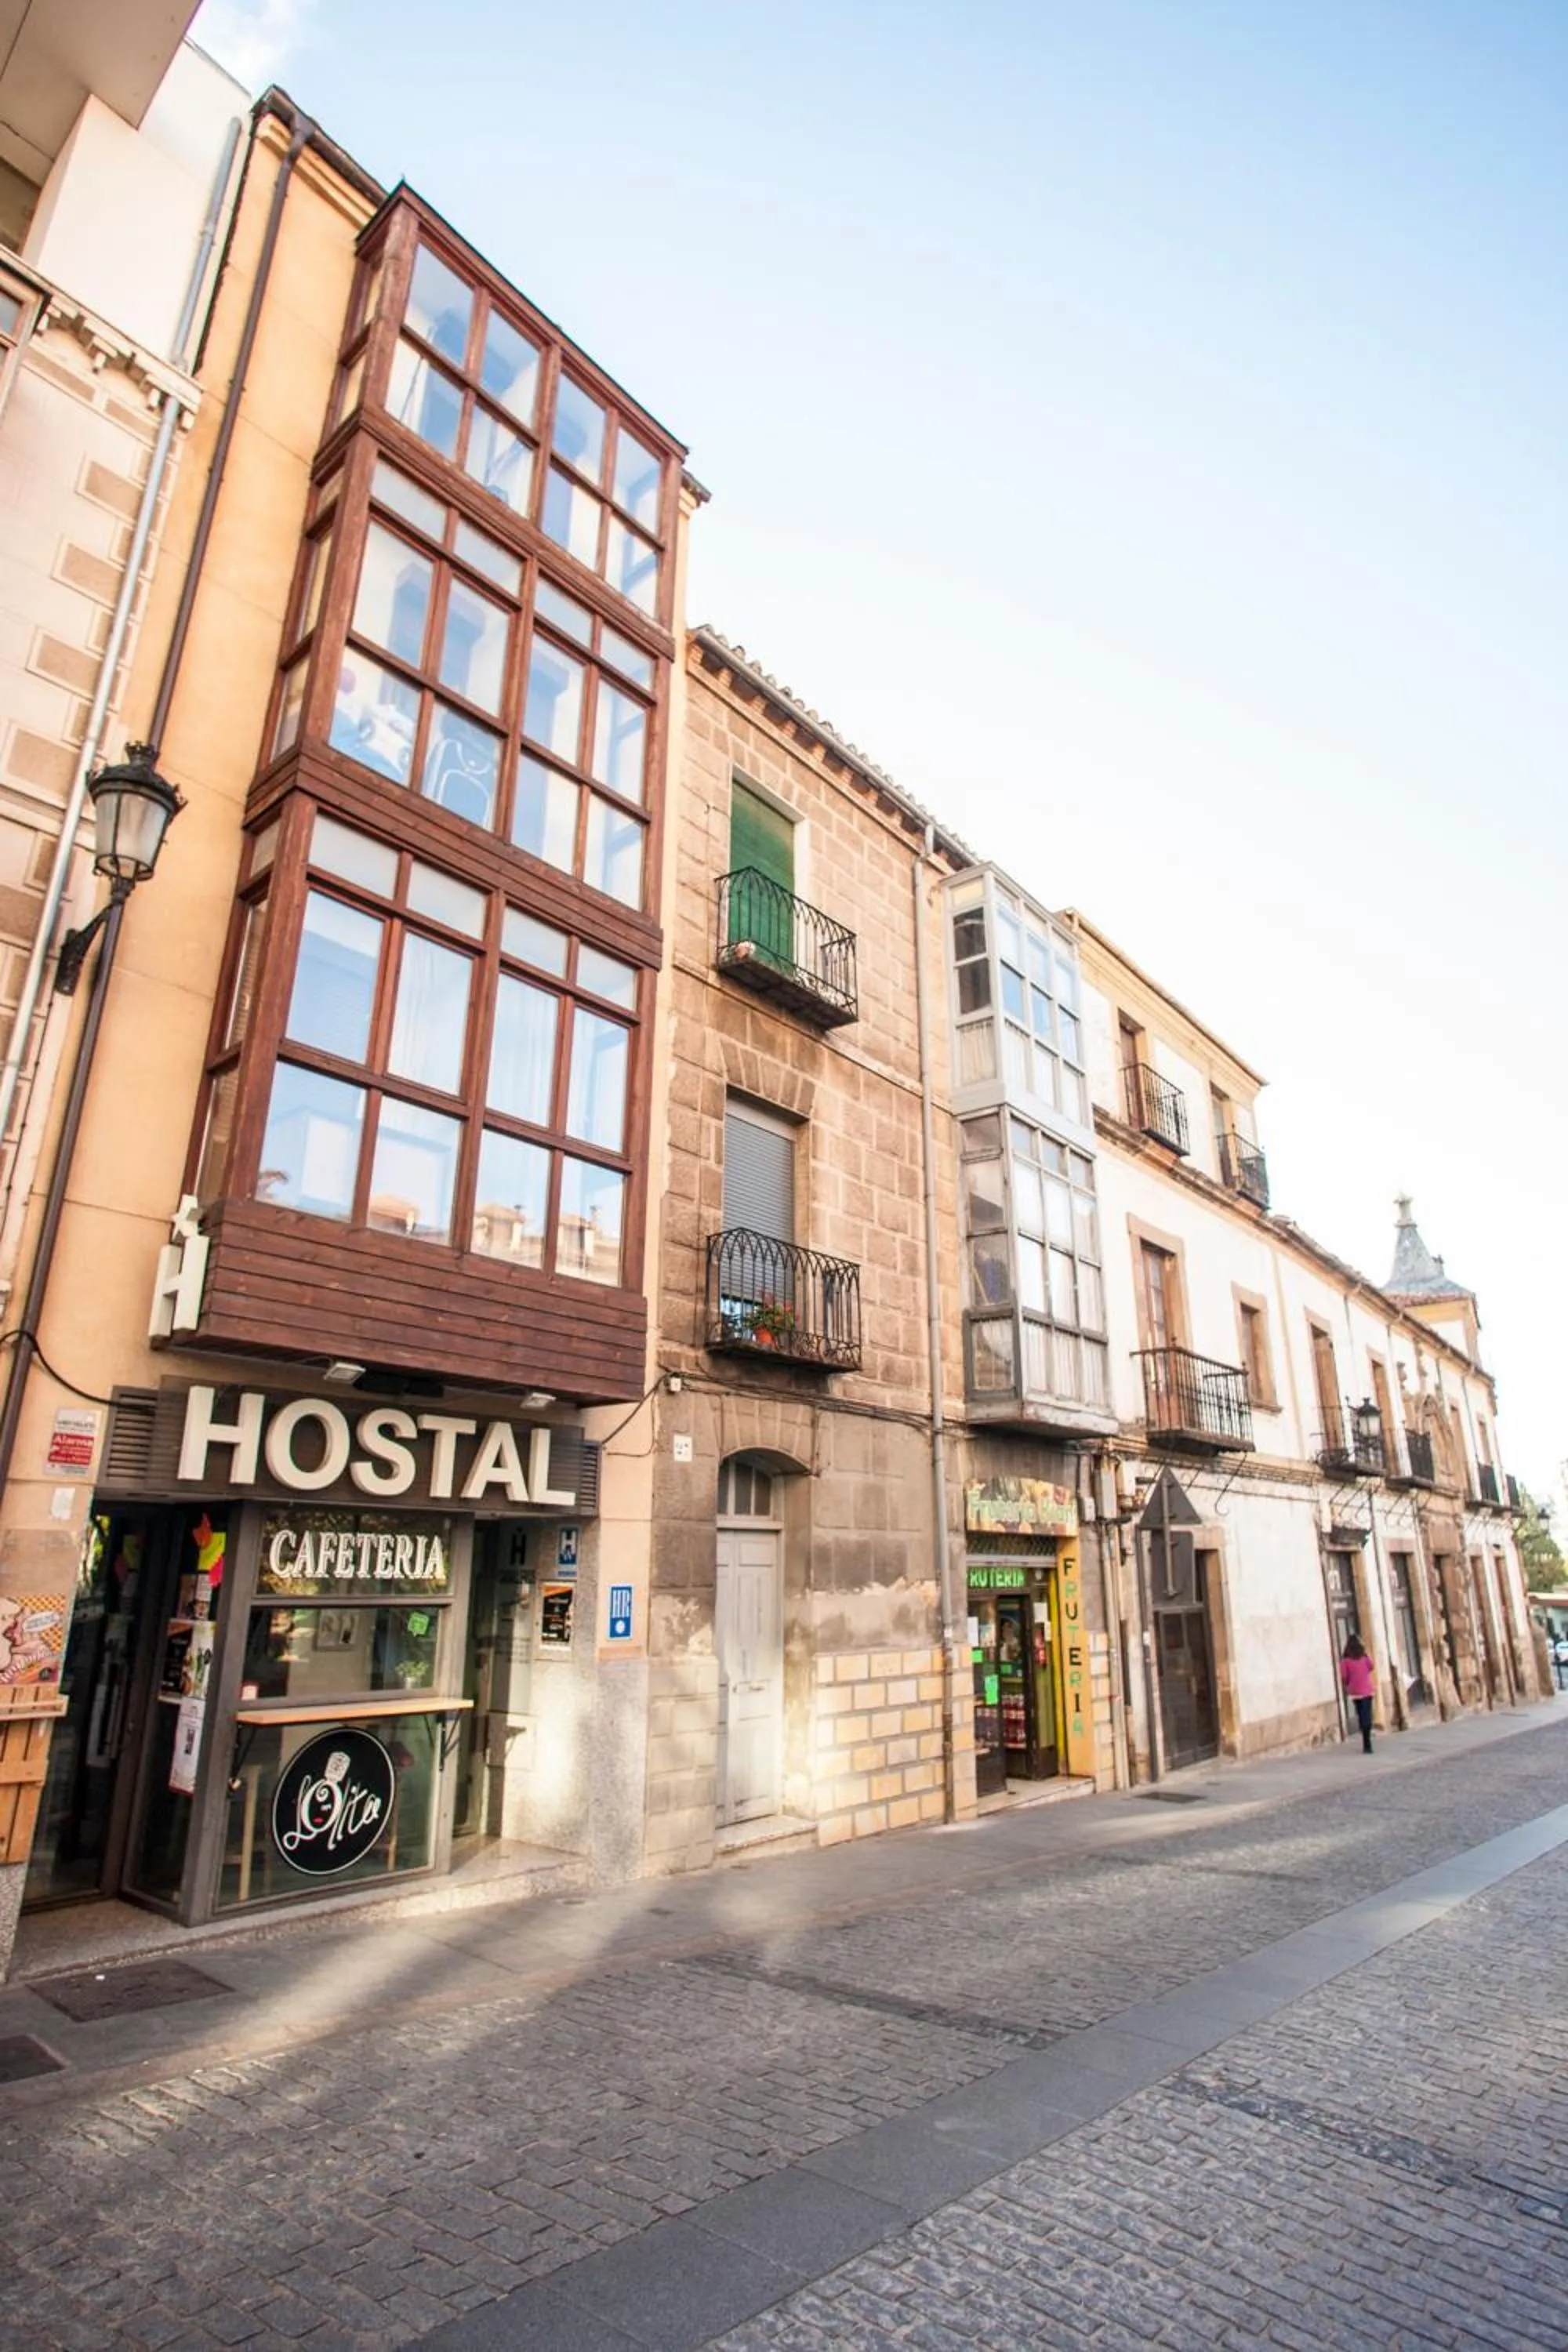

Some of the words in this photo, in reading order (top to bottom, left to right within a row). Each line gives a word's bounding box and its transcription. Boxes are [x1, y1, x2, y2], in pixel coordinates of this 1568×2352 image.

[177, 1385, 576, 1506] HOSTAL
[269, 1530, 446, 1580] CAFETERIA
[966, 1568, 1025, 1588] RUTERIA
[1062, 1558, 1083, 1736] FRUTERIA
